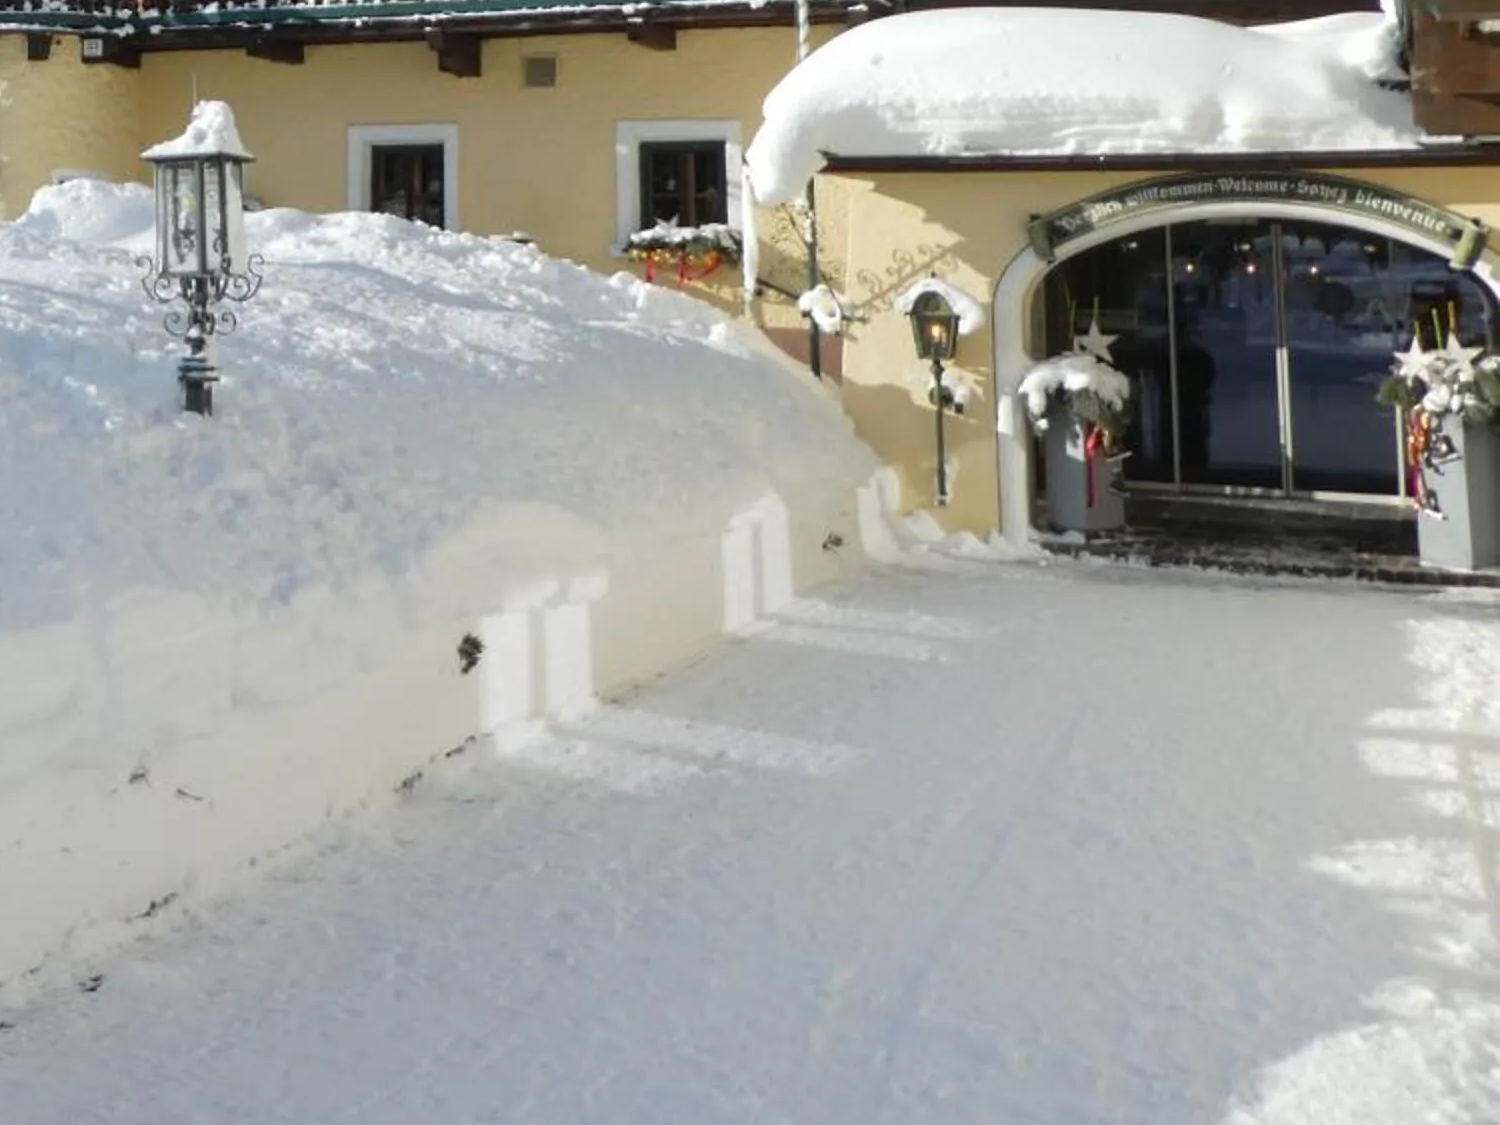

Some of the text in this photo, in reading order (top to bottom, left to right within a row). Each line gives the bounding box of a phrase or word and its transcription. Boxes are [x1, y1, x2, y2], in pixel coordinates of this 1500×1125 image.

[1125, 182, 1213, 207] willkommen
[1217, 177, 1288, 193] Welcome
[1355, 189, 1446, 232] bienvenue
